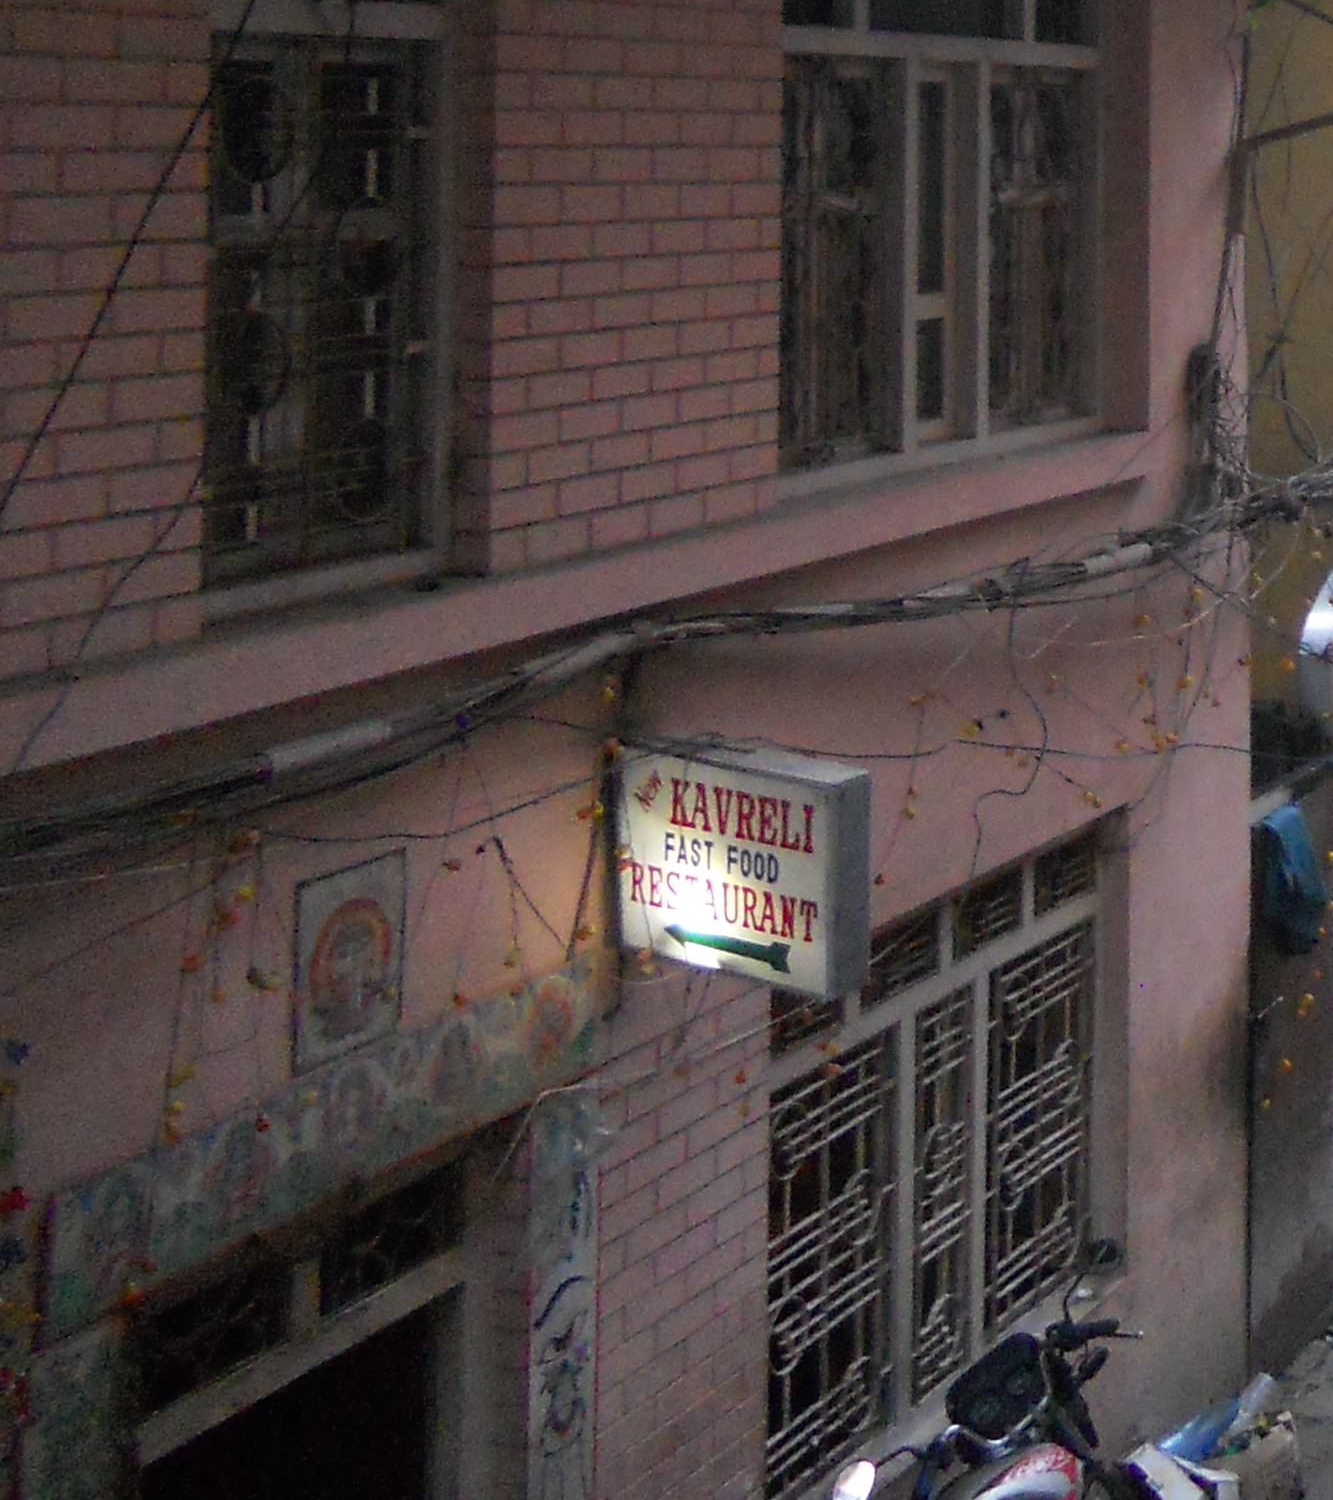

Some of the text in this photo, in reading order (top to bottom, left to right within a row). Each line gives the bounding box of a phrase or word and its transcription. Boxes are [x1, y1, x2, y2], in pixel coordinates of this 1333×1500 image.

[669, 776, 817, 854] KAVRELI
[663, 831, 780, 884] FAST FOOD
